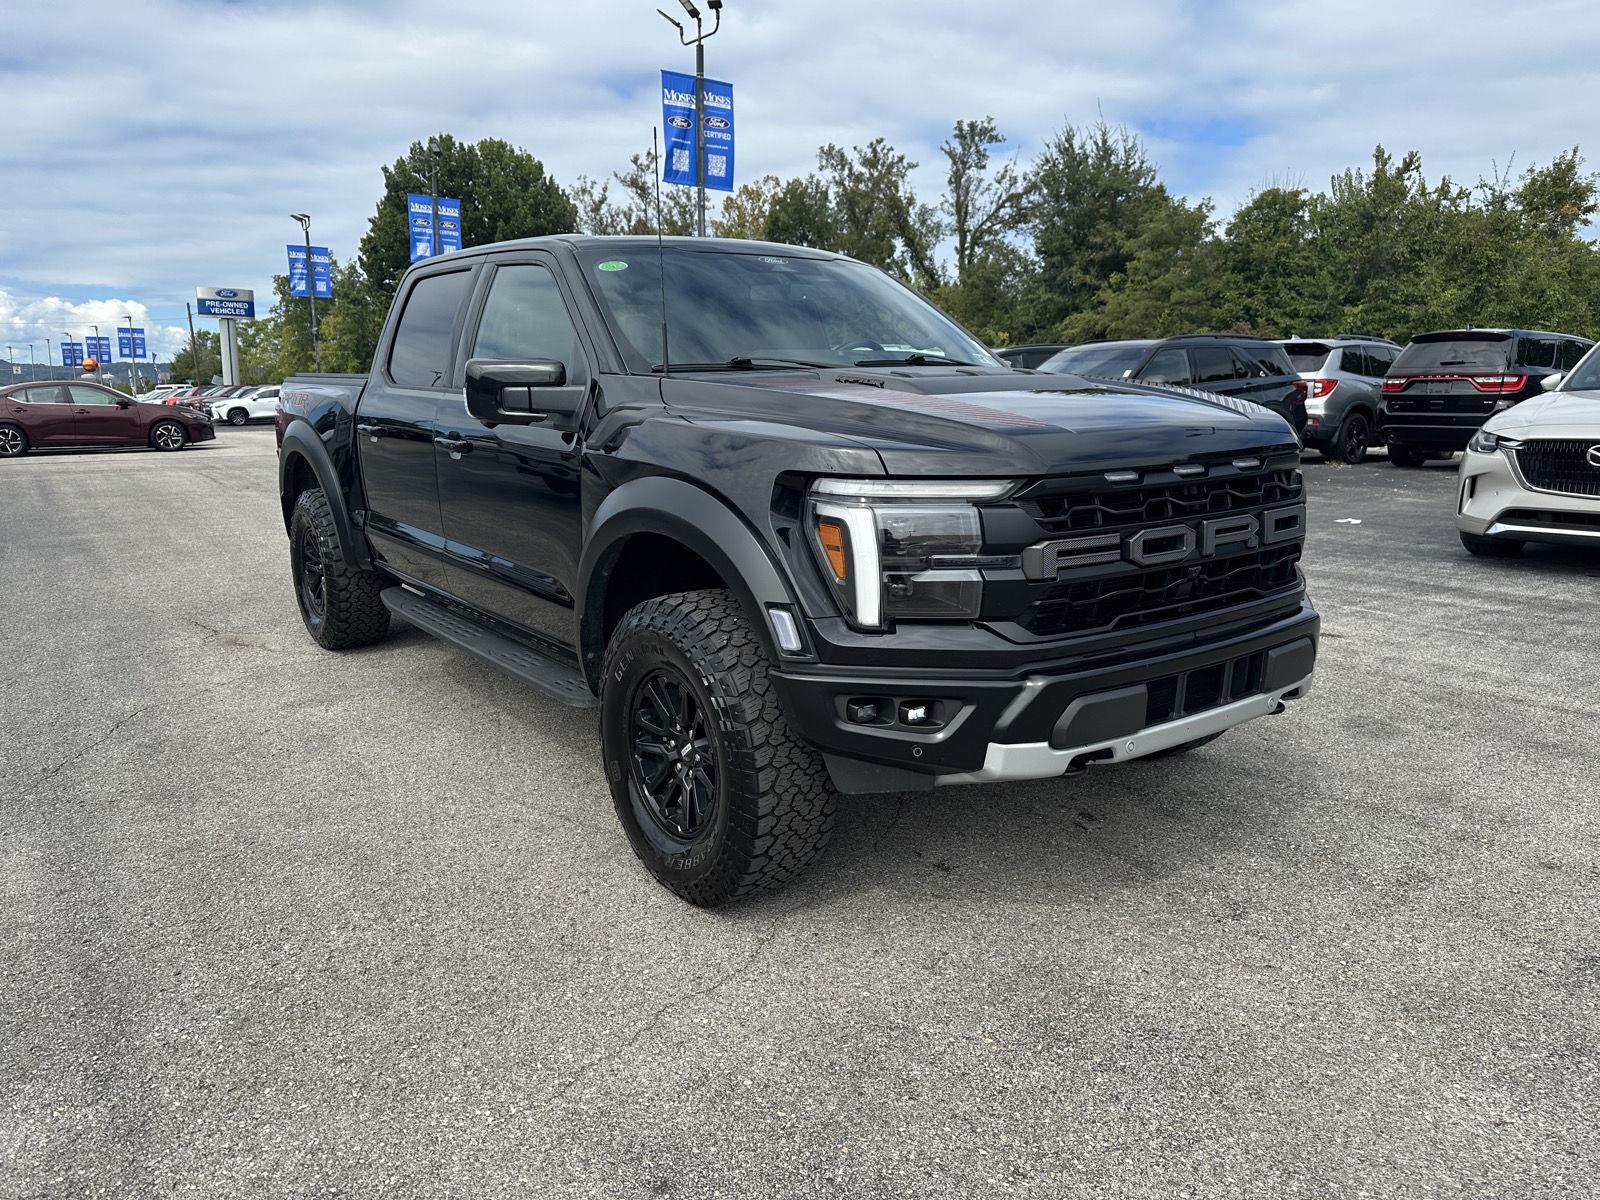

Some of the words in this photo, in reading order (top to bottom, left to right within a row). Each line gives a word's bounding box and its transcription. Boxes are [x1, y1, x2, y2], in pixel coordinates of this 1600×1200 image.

[664, 88, 696, 104] MOSES
[703, 90, 731, 104] MOSES
[703, 130, 731, 140] CERTIFIED
[205, 300, 249, 309] PRE-OWNED
[209, 307, 246, 315] VEHICLES
[1021, 503, 1307, 583] FORD
